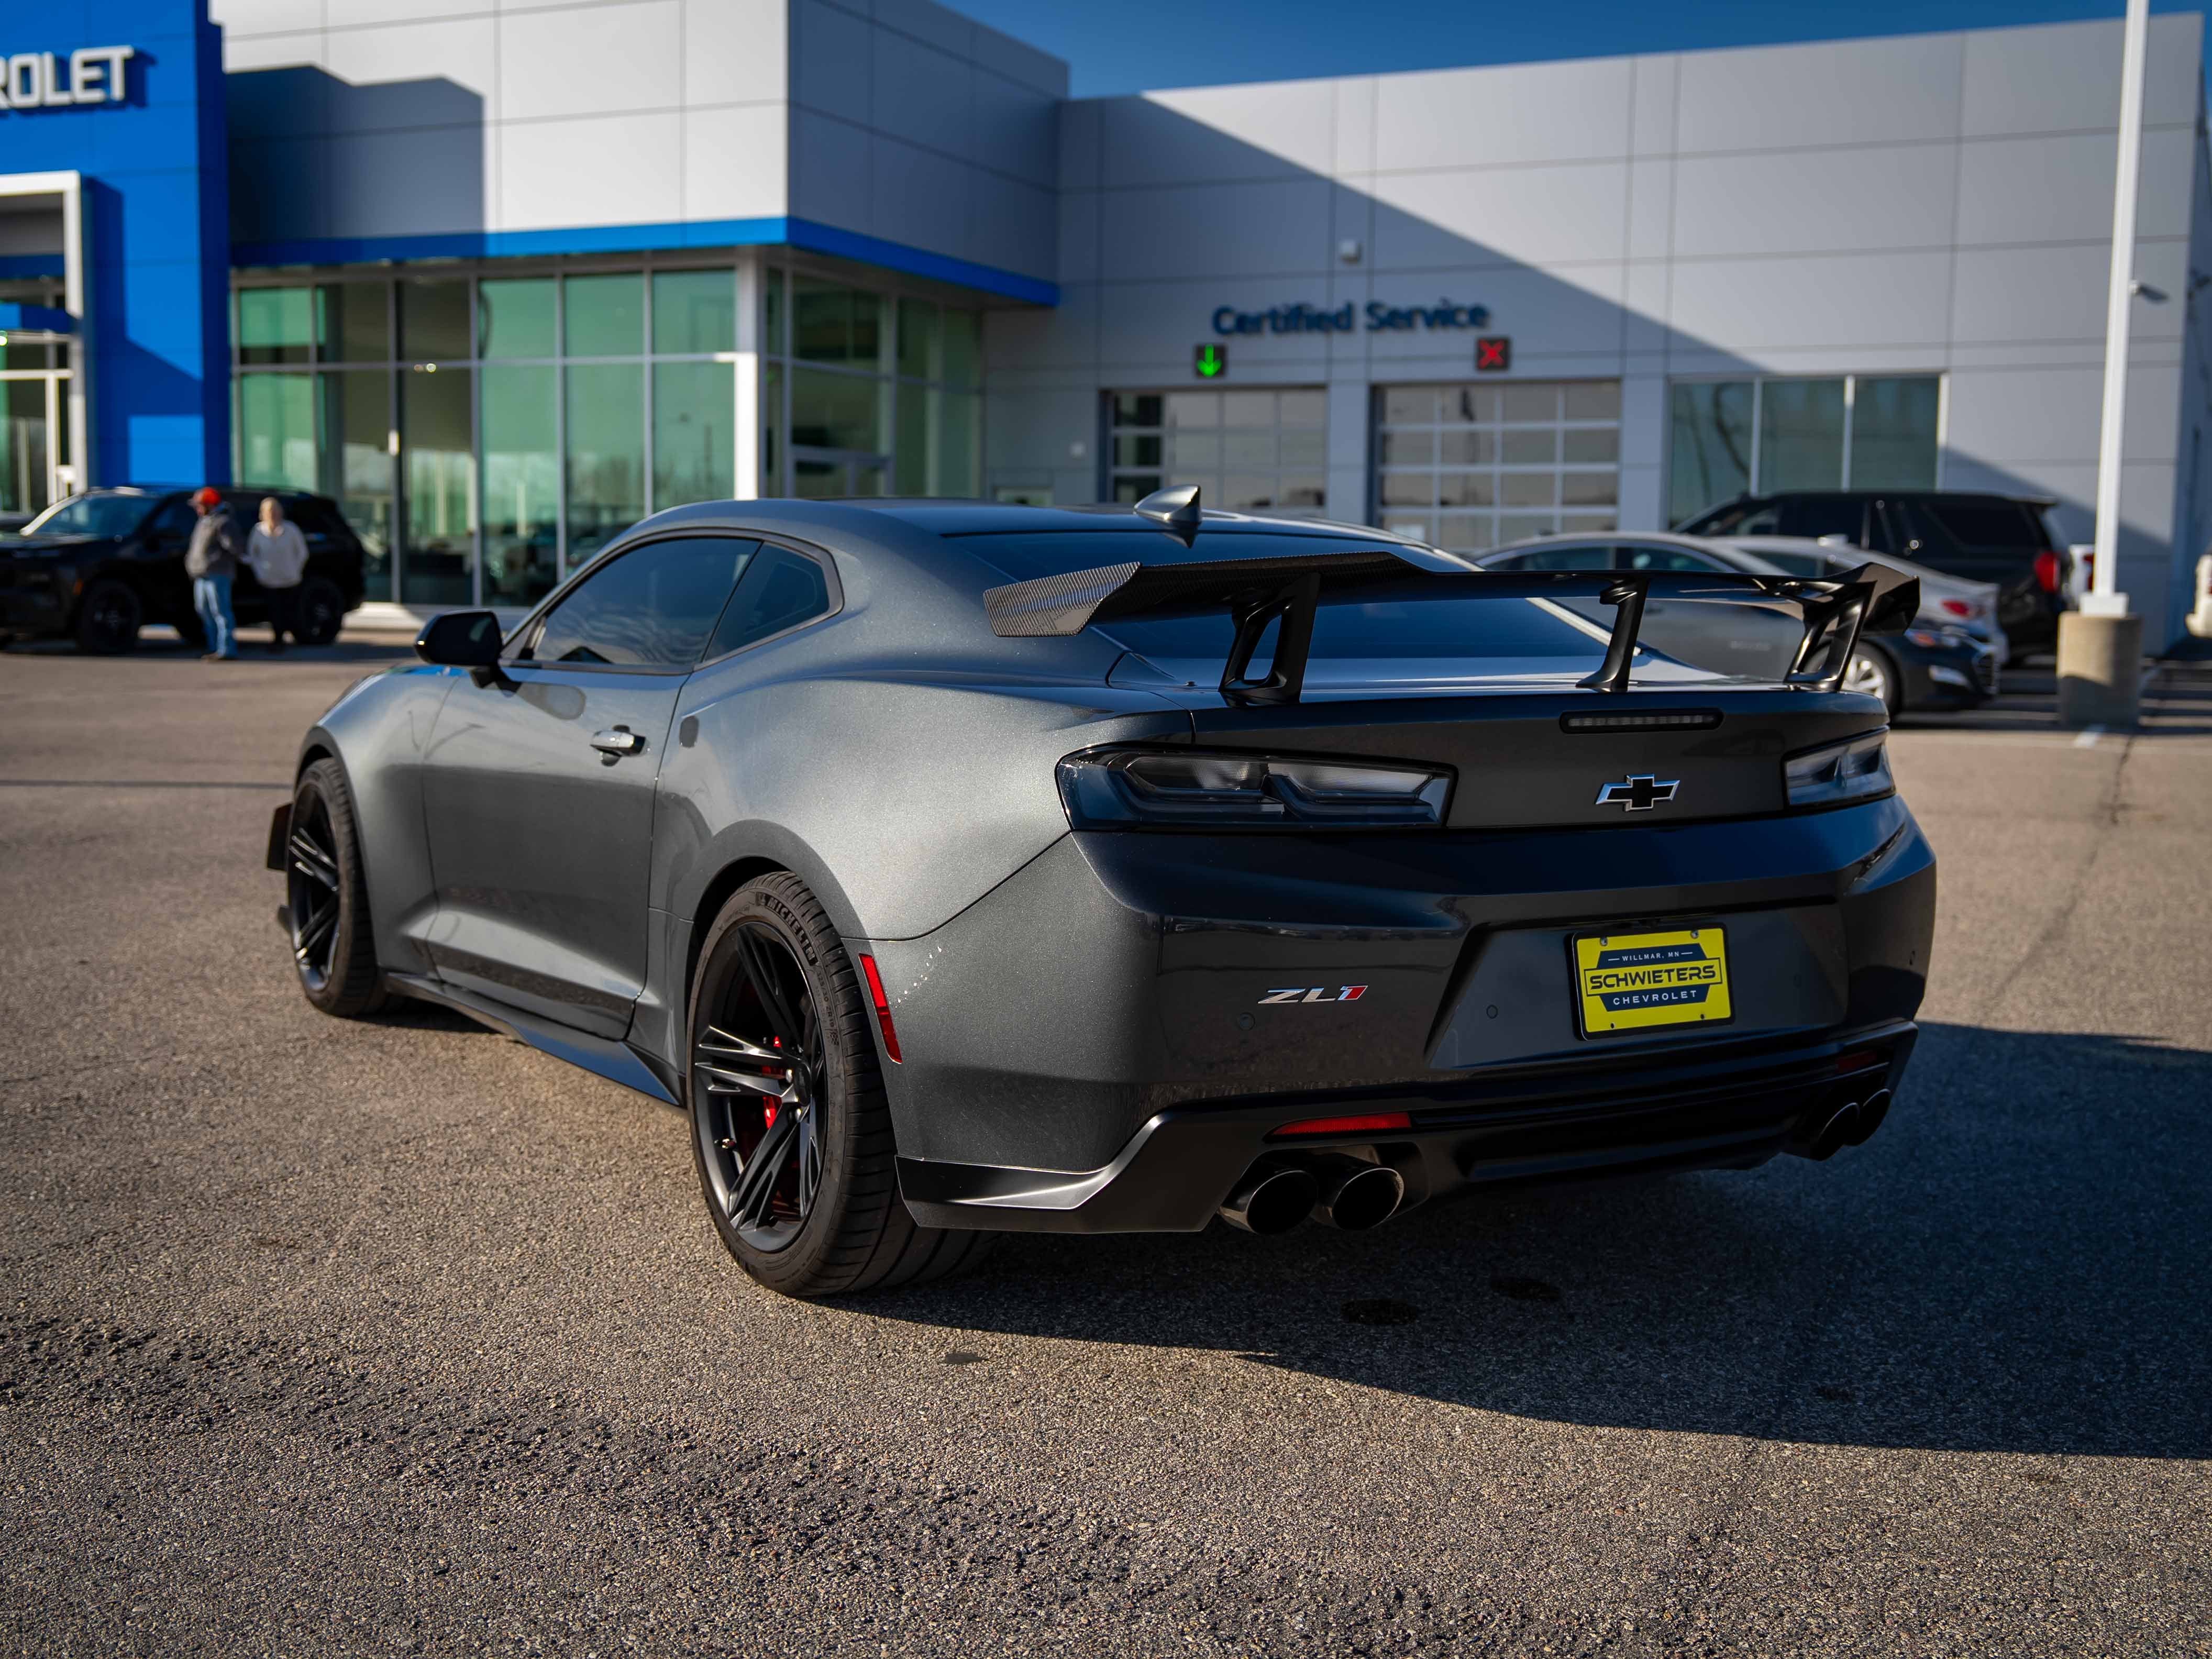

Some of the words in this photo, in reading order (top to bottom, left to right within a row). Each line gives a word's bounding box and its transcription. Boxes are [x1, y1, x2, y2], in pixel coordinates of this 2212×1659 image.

[0, 45, 135, 109] OLET
[1212, 302, 1353, 336] Certified
[1365, 296, 1490, 332] Service
[766, 897, 816, 960] MICHELIN
[1622, 953, 1664, 961] WILLMAR,
[1589, 965, 1717, 990] SCHWIETERS
[1257, 985, 1368, 1004] ZL1
[1613, 990, 1697, 1005] CHEVROLET
